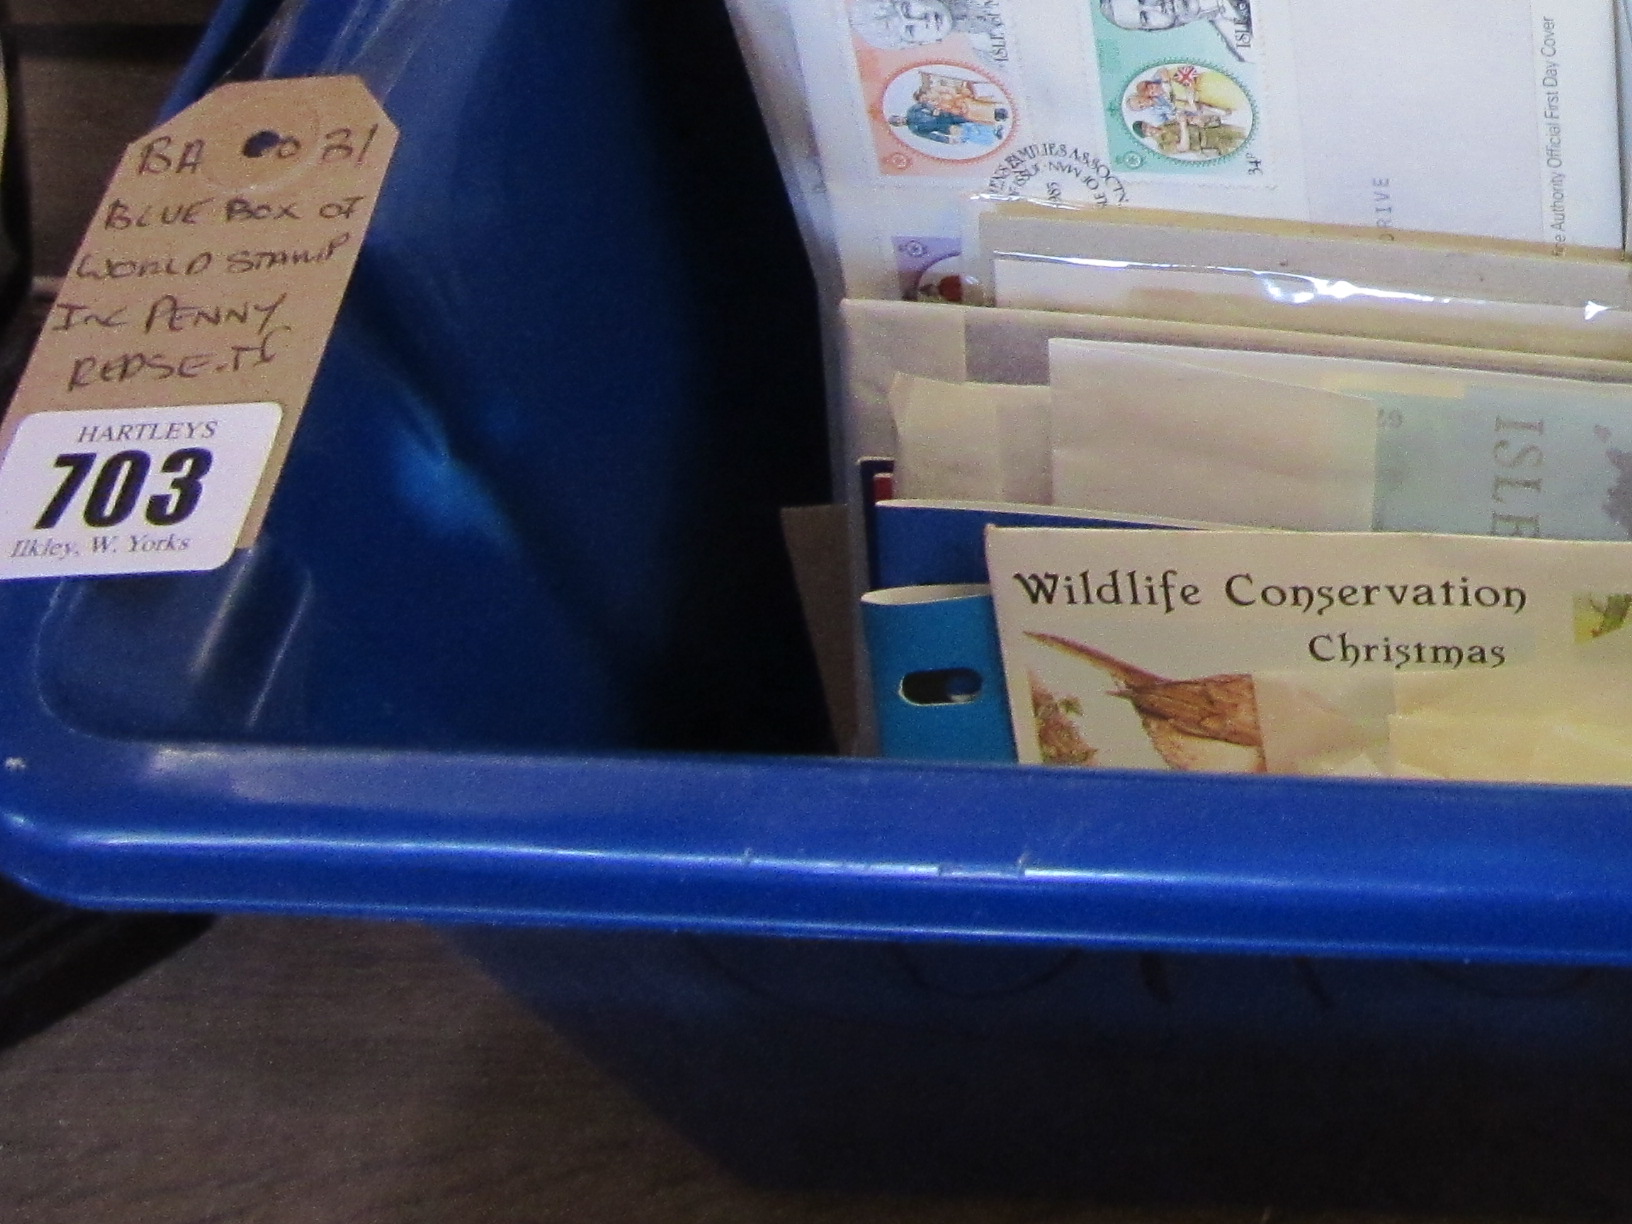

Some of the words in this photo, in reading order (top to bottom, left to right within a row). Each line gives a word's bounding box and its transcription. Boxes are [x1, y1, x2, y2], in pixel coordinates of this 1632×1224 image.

[1540, 16, 1556, 58] Cover
[1542, 61, 1560, 87] Day
[1544, 90, 1559, 120] First
[1546, 122, 1563, 168] Official
[104, 197, 214, 230] BLUE
[1550, 174, 1566, 231] Authority
[76, 252, 213, 279] WORLD
[144, 292, 287, 334] PENNY
[77, 420, 219, 443] HARTLEYS
[33, 447, 214, 530] 703
[91, 535, 118, 554] W.
[128, 533, 191, 553] Yorks
[1013, 568, 1201, 614] Wildlife
[1224, 572, 1528, 616] Conservation
[1307, 632, 1507, 670] Christmas
